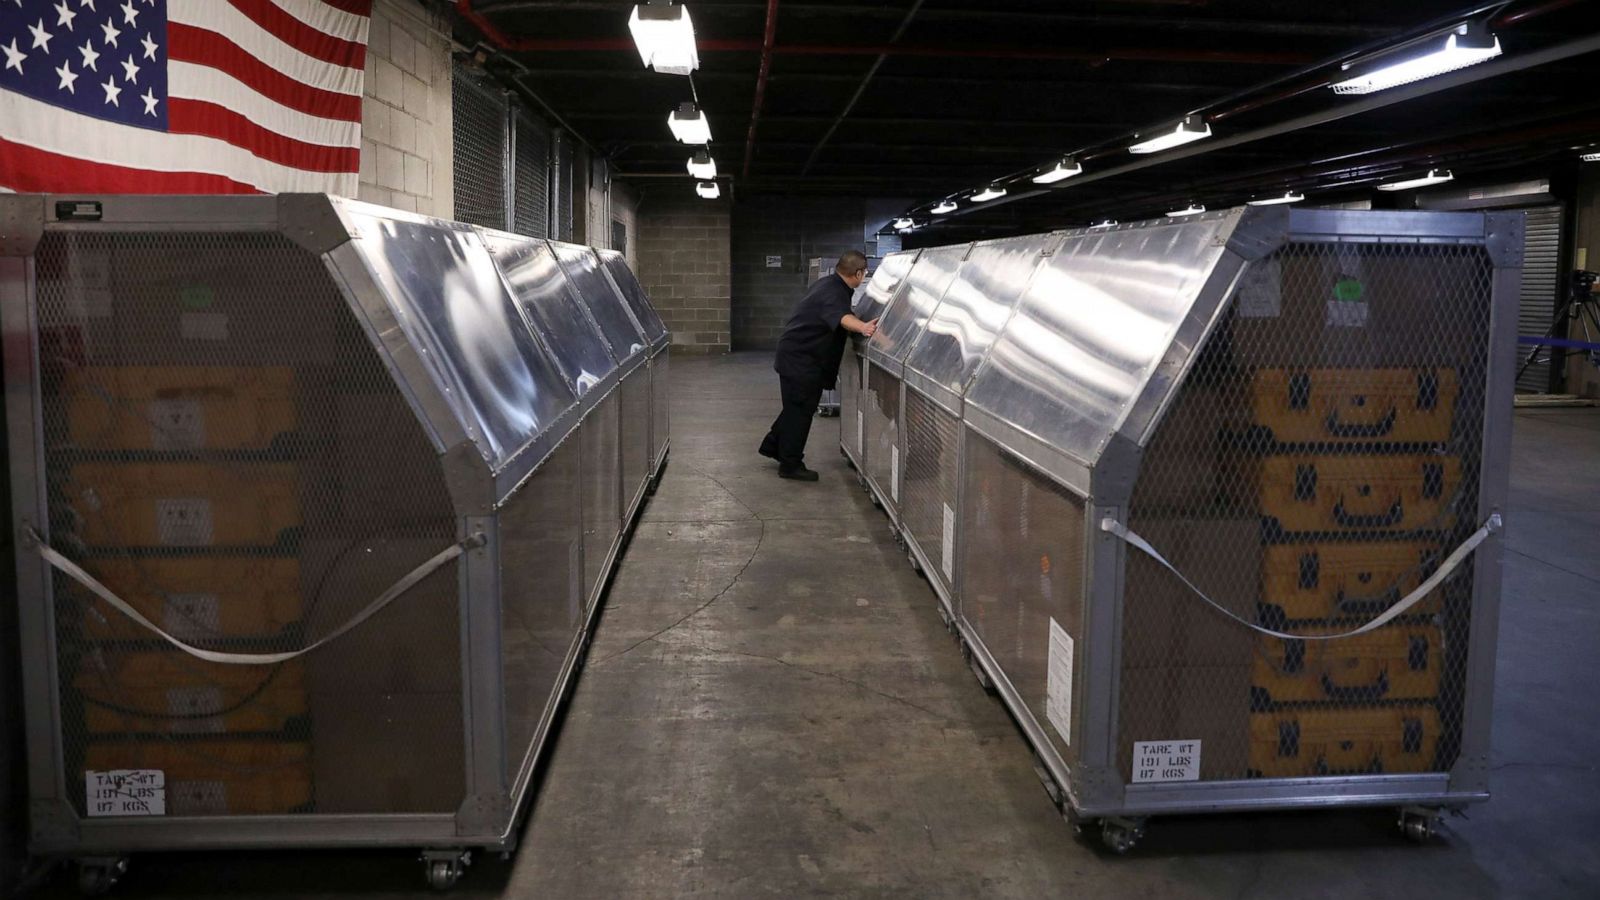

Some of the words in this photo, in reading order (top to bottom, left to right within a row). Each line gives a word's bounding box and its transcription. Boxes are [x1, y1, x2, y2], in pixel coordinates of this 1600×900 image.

[1142, 745, 1172, 755] TARE
[1179, 744, 1194, 754] WT
[1141, 757, 1160, 767] 191
[1168, 756, 1192, 766] LBS
[1140, 769, 1155, 779] 87
[1162, 768, 1185, 778] KGS
[96, 775, 133, 787] TARE
[129, 787, 155, 799] LBS
[123, 801, 149, 812] KGS
